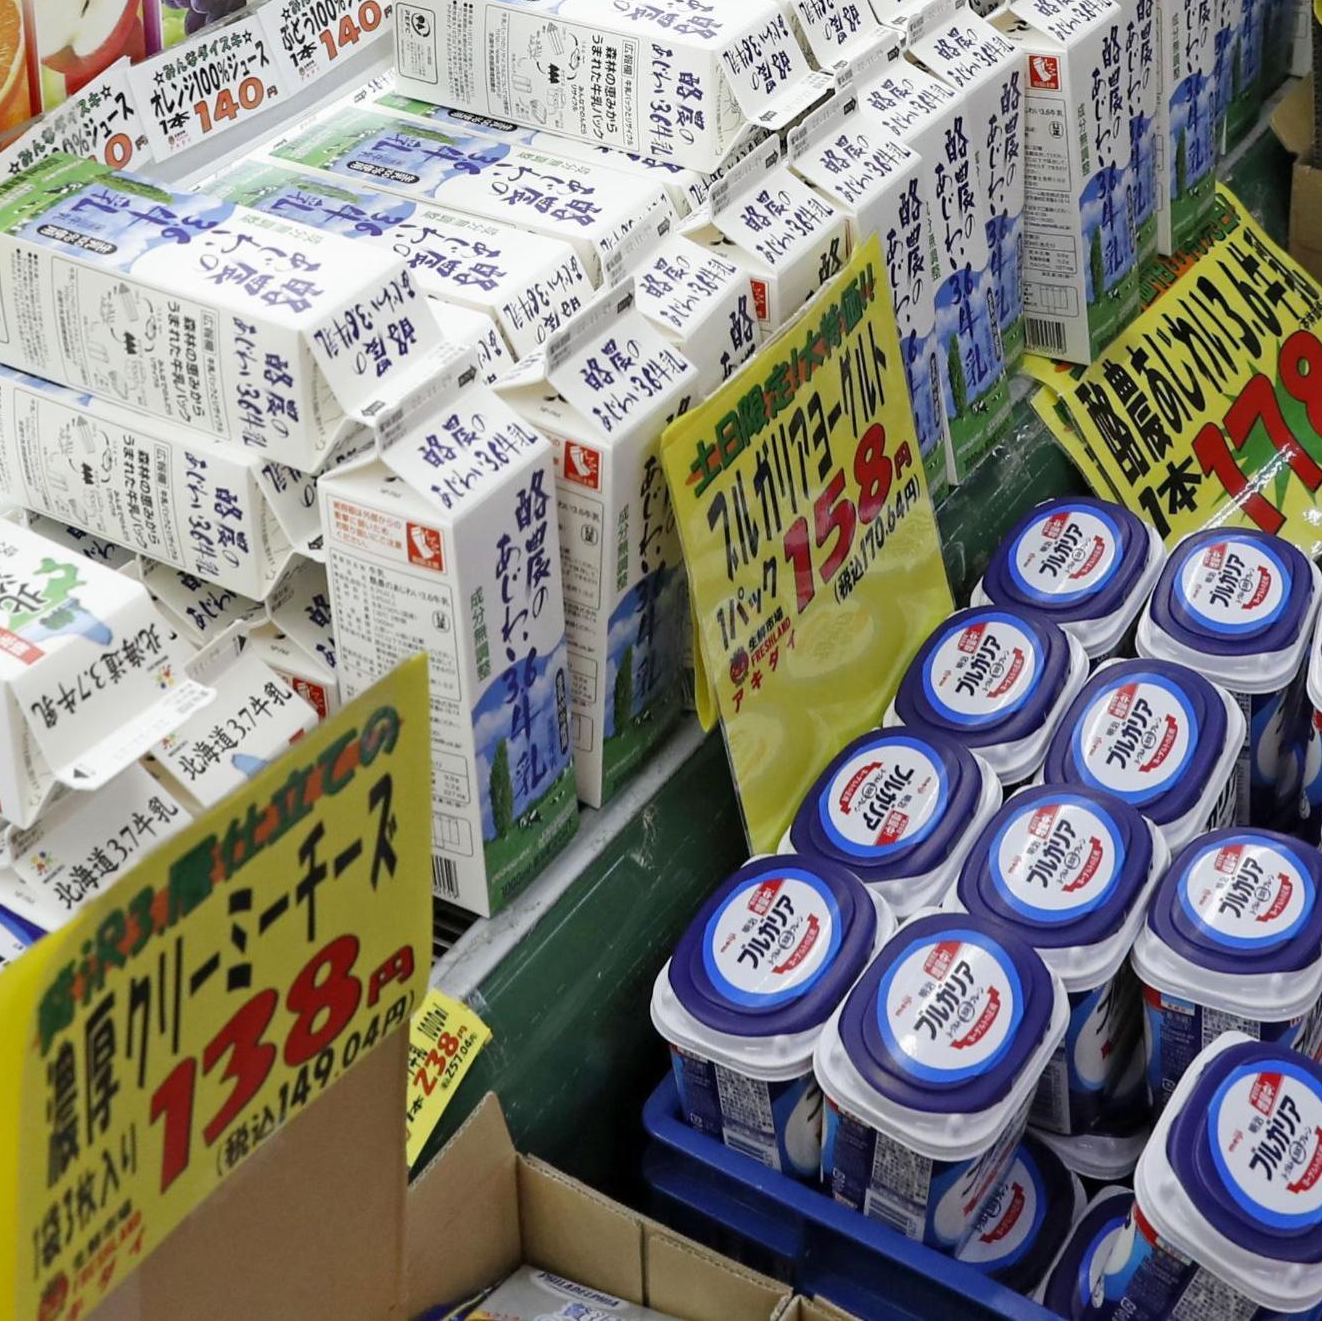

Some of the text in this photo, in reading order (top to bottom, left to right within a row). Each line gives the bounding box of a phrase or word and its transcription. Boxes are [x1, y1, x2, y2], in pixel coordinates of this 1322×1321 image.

[150, 39, 270, 120] オレンジ100%ジュース
[289, 41, 317, 68] 1本
[1142, 462, 1199, 534] 1本
[513, 468, 552, 622] 酪農の
[1040, 522, 1086, 579] ブルガリア
[1211, 553, 1246, 609] ブルガリア
[1105, 696, 1153, 771] ブルガリア
[53, 801, 179, 912] 北海道3.7牛乳
[916, 958, 977, 1043] ブルガリア
[1248, 1086, 1303, 1183] ブルガリア
